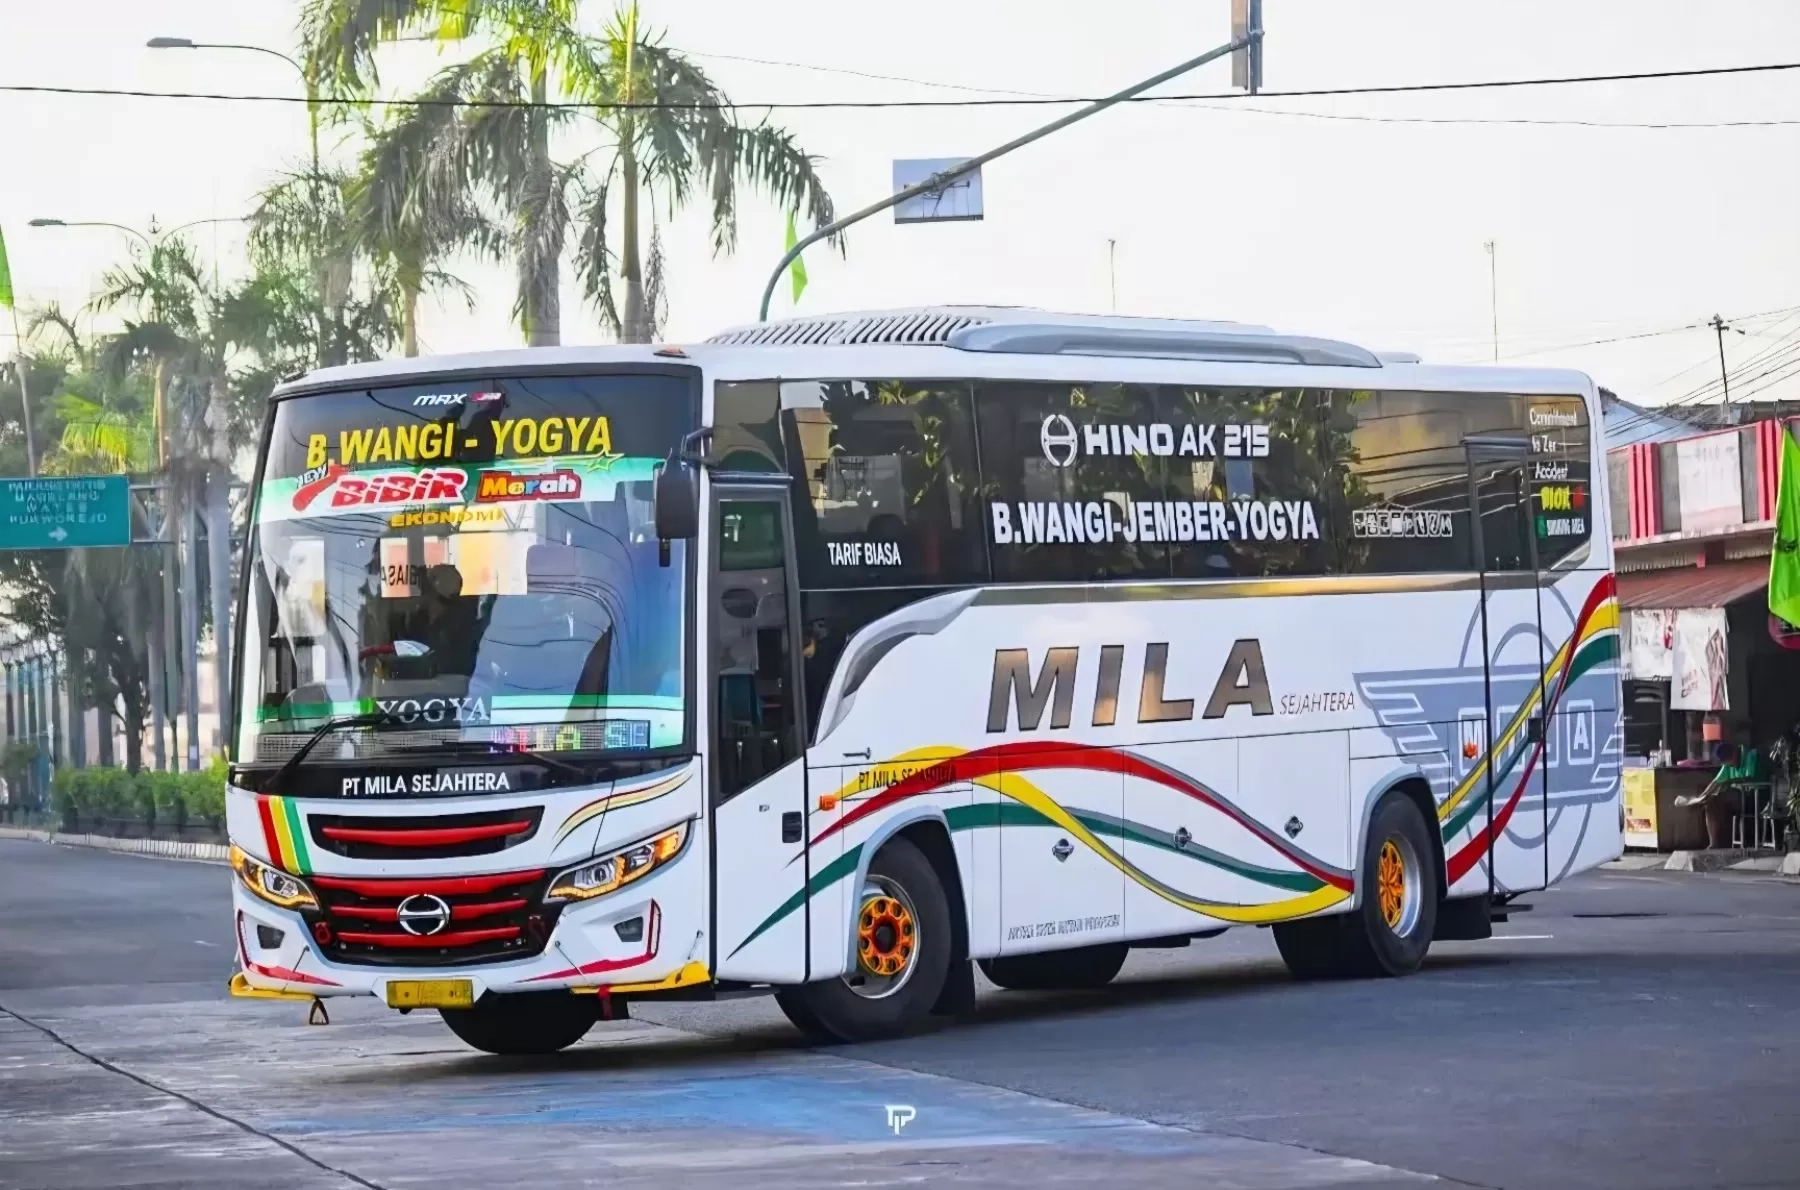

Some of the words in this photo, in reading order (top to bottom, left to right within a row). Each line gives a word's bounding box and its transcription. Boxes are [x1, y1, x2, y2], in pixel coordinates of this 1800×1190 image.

[340, 422, 455, 466] WANGI
[491, 416, 612, 456] YOGYA
[1084, 424, 1174, 456] HINO
[1179, 424, 1216, 456] AK
[1224, 424, 1270, 457] 215
[481, 473, 577, 497] Merah
[991, 500, 1320, 544] B.WANGI-JEMBER-YOGYA
[827, 543, 862, 566] TARIF
[865, 542, 902, 566] BIASA
[986, 638, 1275, 734] MILA
[1280, 690, 1355, 716] SEJAHTERA
[375, 697, 491, 725] YOGYA
[342, 778, 360, 796] PT
[365, 774, 406, 795] MILA
[412, 771, 510, 793] SEJAHTERA
